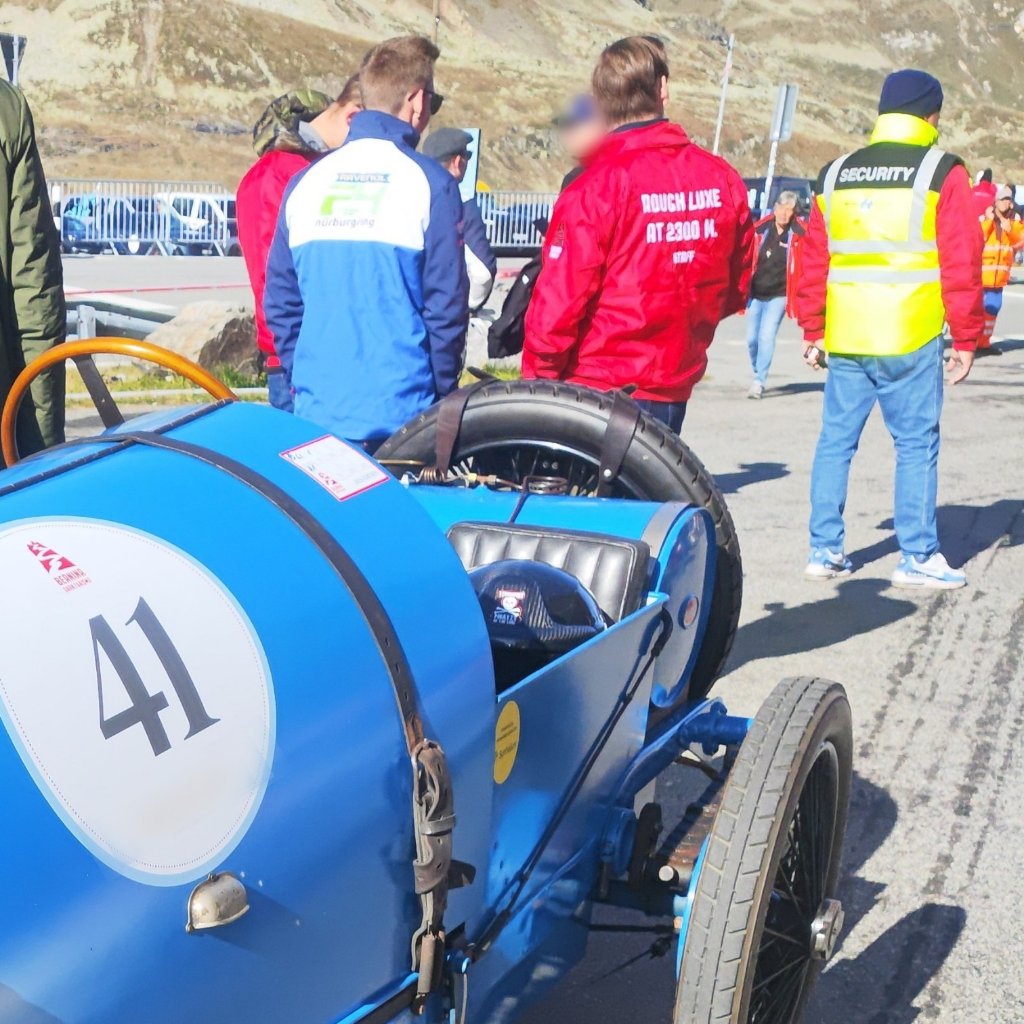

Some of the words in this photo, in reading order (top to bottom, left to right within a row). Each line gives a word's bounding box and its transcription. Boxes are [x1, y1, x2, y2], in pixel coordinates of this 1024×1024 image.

[839, 166, 915, 183] SECURITY
[641, 192, 686, 214] ROUGH
[688, 188, 722, 211] LUXE
[646, 222, 665, 244] AT
[666, 220, 700, 242] 2300
[704, 218, 718, 239] M.
[54, 568, 86, 586] BERNINA
[88, 596, 221, 757] 41
